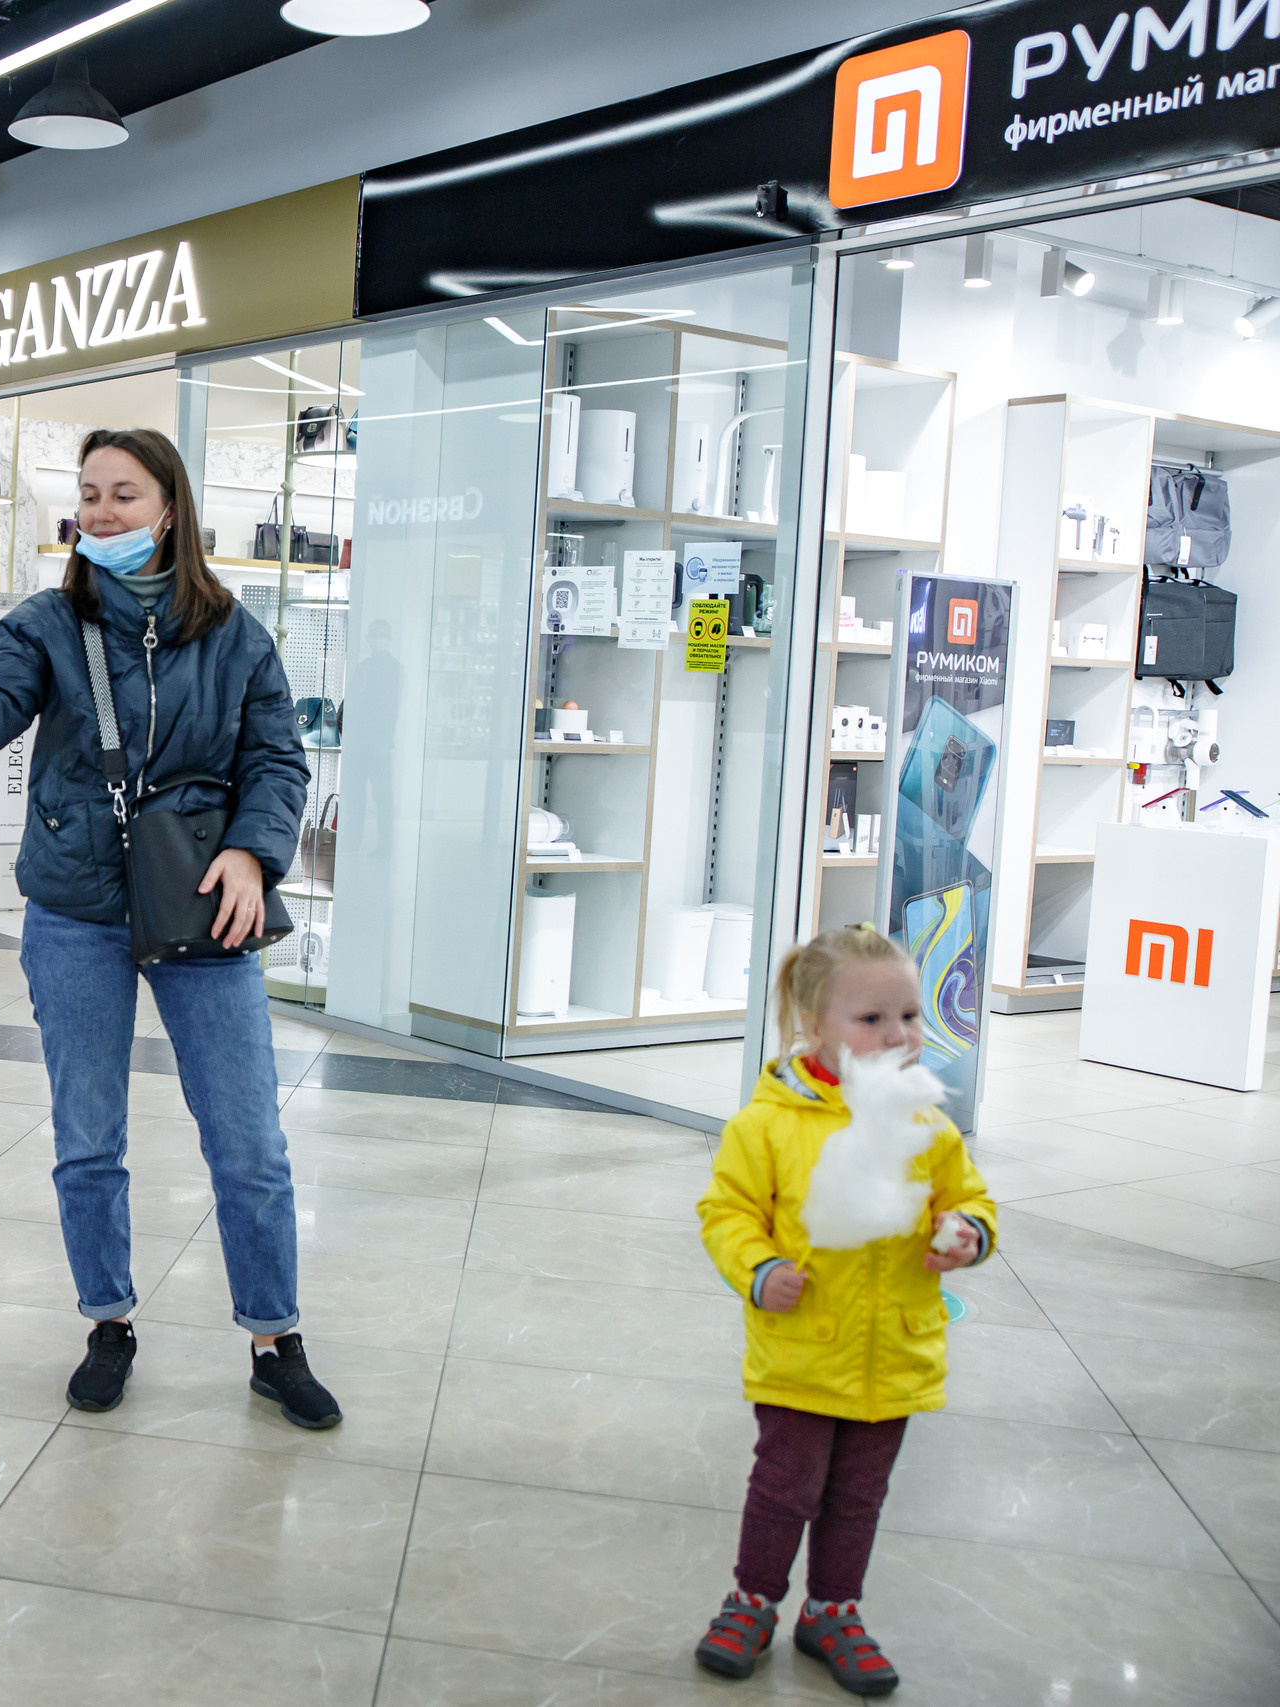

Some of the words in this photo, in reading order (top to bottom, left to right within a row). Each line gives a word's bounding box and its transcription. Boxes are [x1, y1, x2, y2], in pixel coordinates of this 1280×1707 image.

[1004, 74, 1204, 151] фирменный
[915, 673, 953, 683] фирменный
[979, 676, 998, 685] Xiaomi
[916, 650, 1000, 674] РУМИКОМ
[8, 734, 25, 796] ELEG
